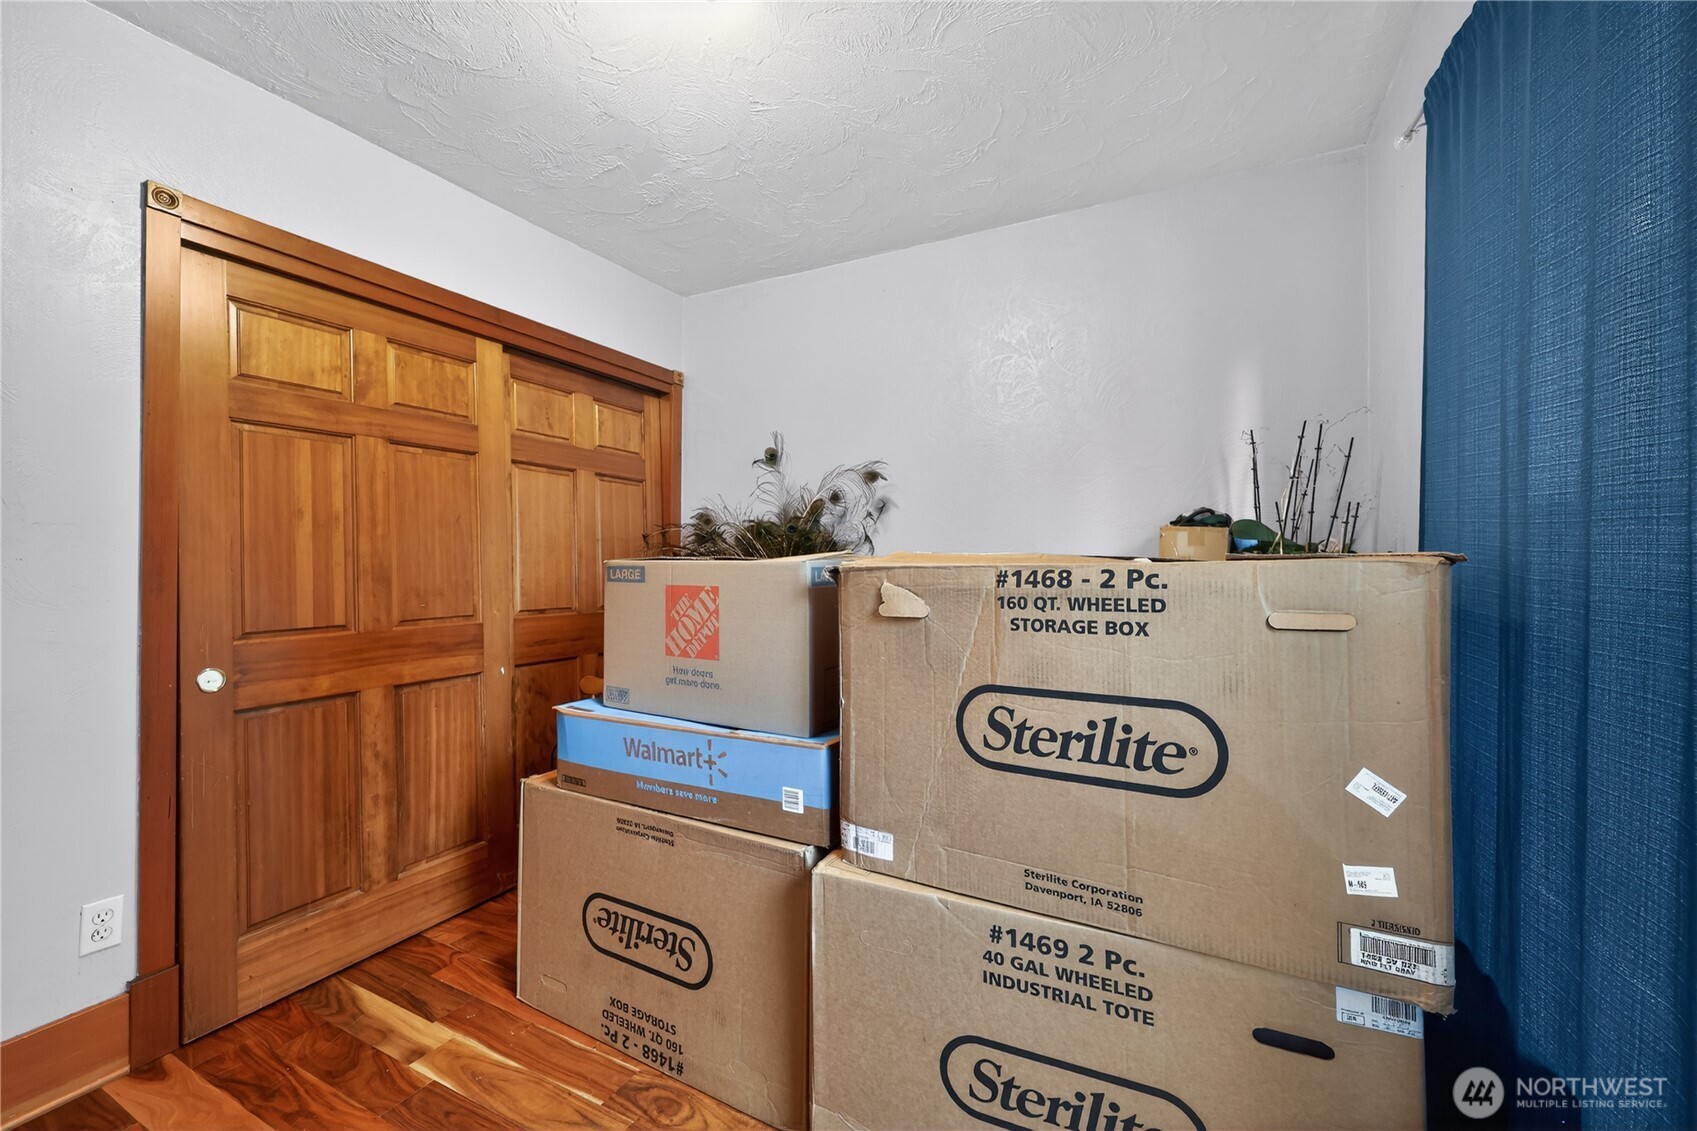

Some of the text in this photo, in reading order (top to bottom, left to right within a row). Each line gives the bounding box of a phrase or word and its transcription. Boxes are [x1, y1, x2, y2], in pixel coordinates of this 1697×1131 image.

[610, 568, 641, 580] LARGE
[996, 569, 1073, 589] #1468
[1100, 569, 1115, 589] 2
[1127, 569, 1168, 590] Pc.
[666, 586, 719, 656] HOME
[671, 592, 692, 621] THE
[997, 596, 1167, 613] 160 QT. WHEELED
[685, 613, 719, 658] DEPOT
[1010, 617, 1150, 637] STORAGE BOX
[1023, 869, 1144, 904] Sterilite Corporation
[1025, 882, 1143, 917] Davenport, IA 52806
[597, 907, 696, 972] Sterilite
[989, 925, 1145, 978] #1469 2 Pc.
[983, 950, 1153, 1002] 40 GAL WHEELED
[983, 970, 1155, 1026] INDUSTRIAL TOTE
[600, 1023, 618, 1044] Pc.
[602, 1009, 684, 1055] 160 QT. WHEELED
[609, 996, 676, 1036] STORAGE BOX
[622, 1034, 630, 1050] 2
[642, 1044, 684, 1076] #1468
[968, 1058, 1163, 1131] Sterilit
